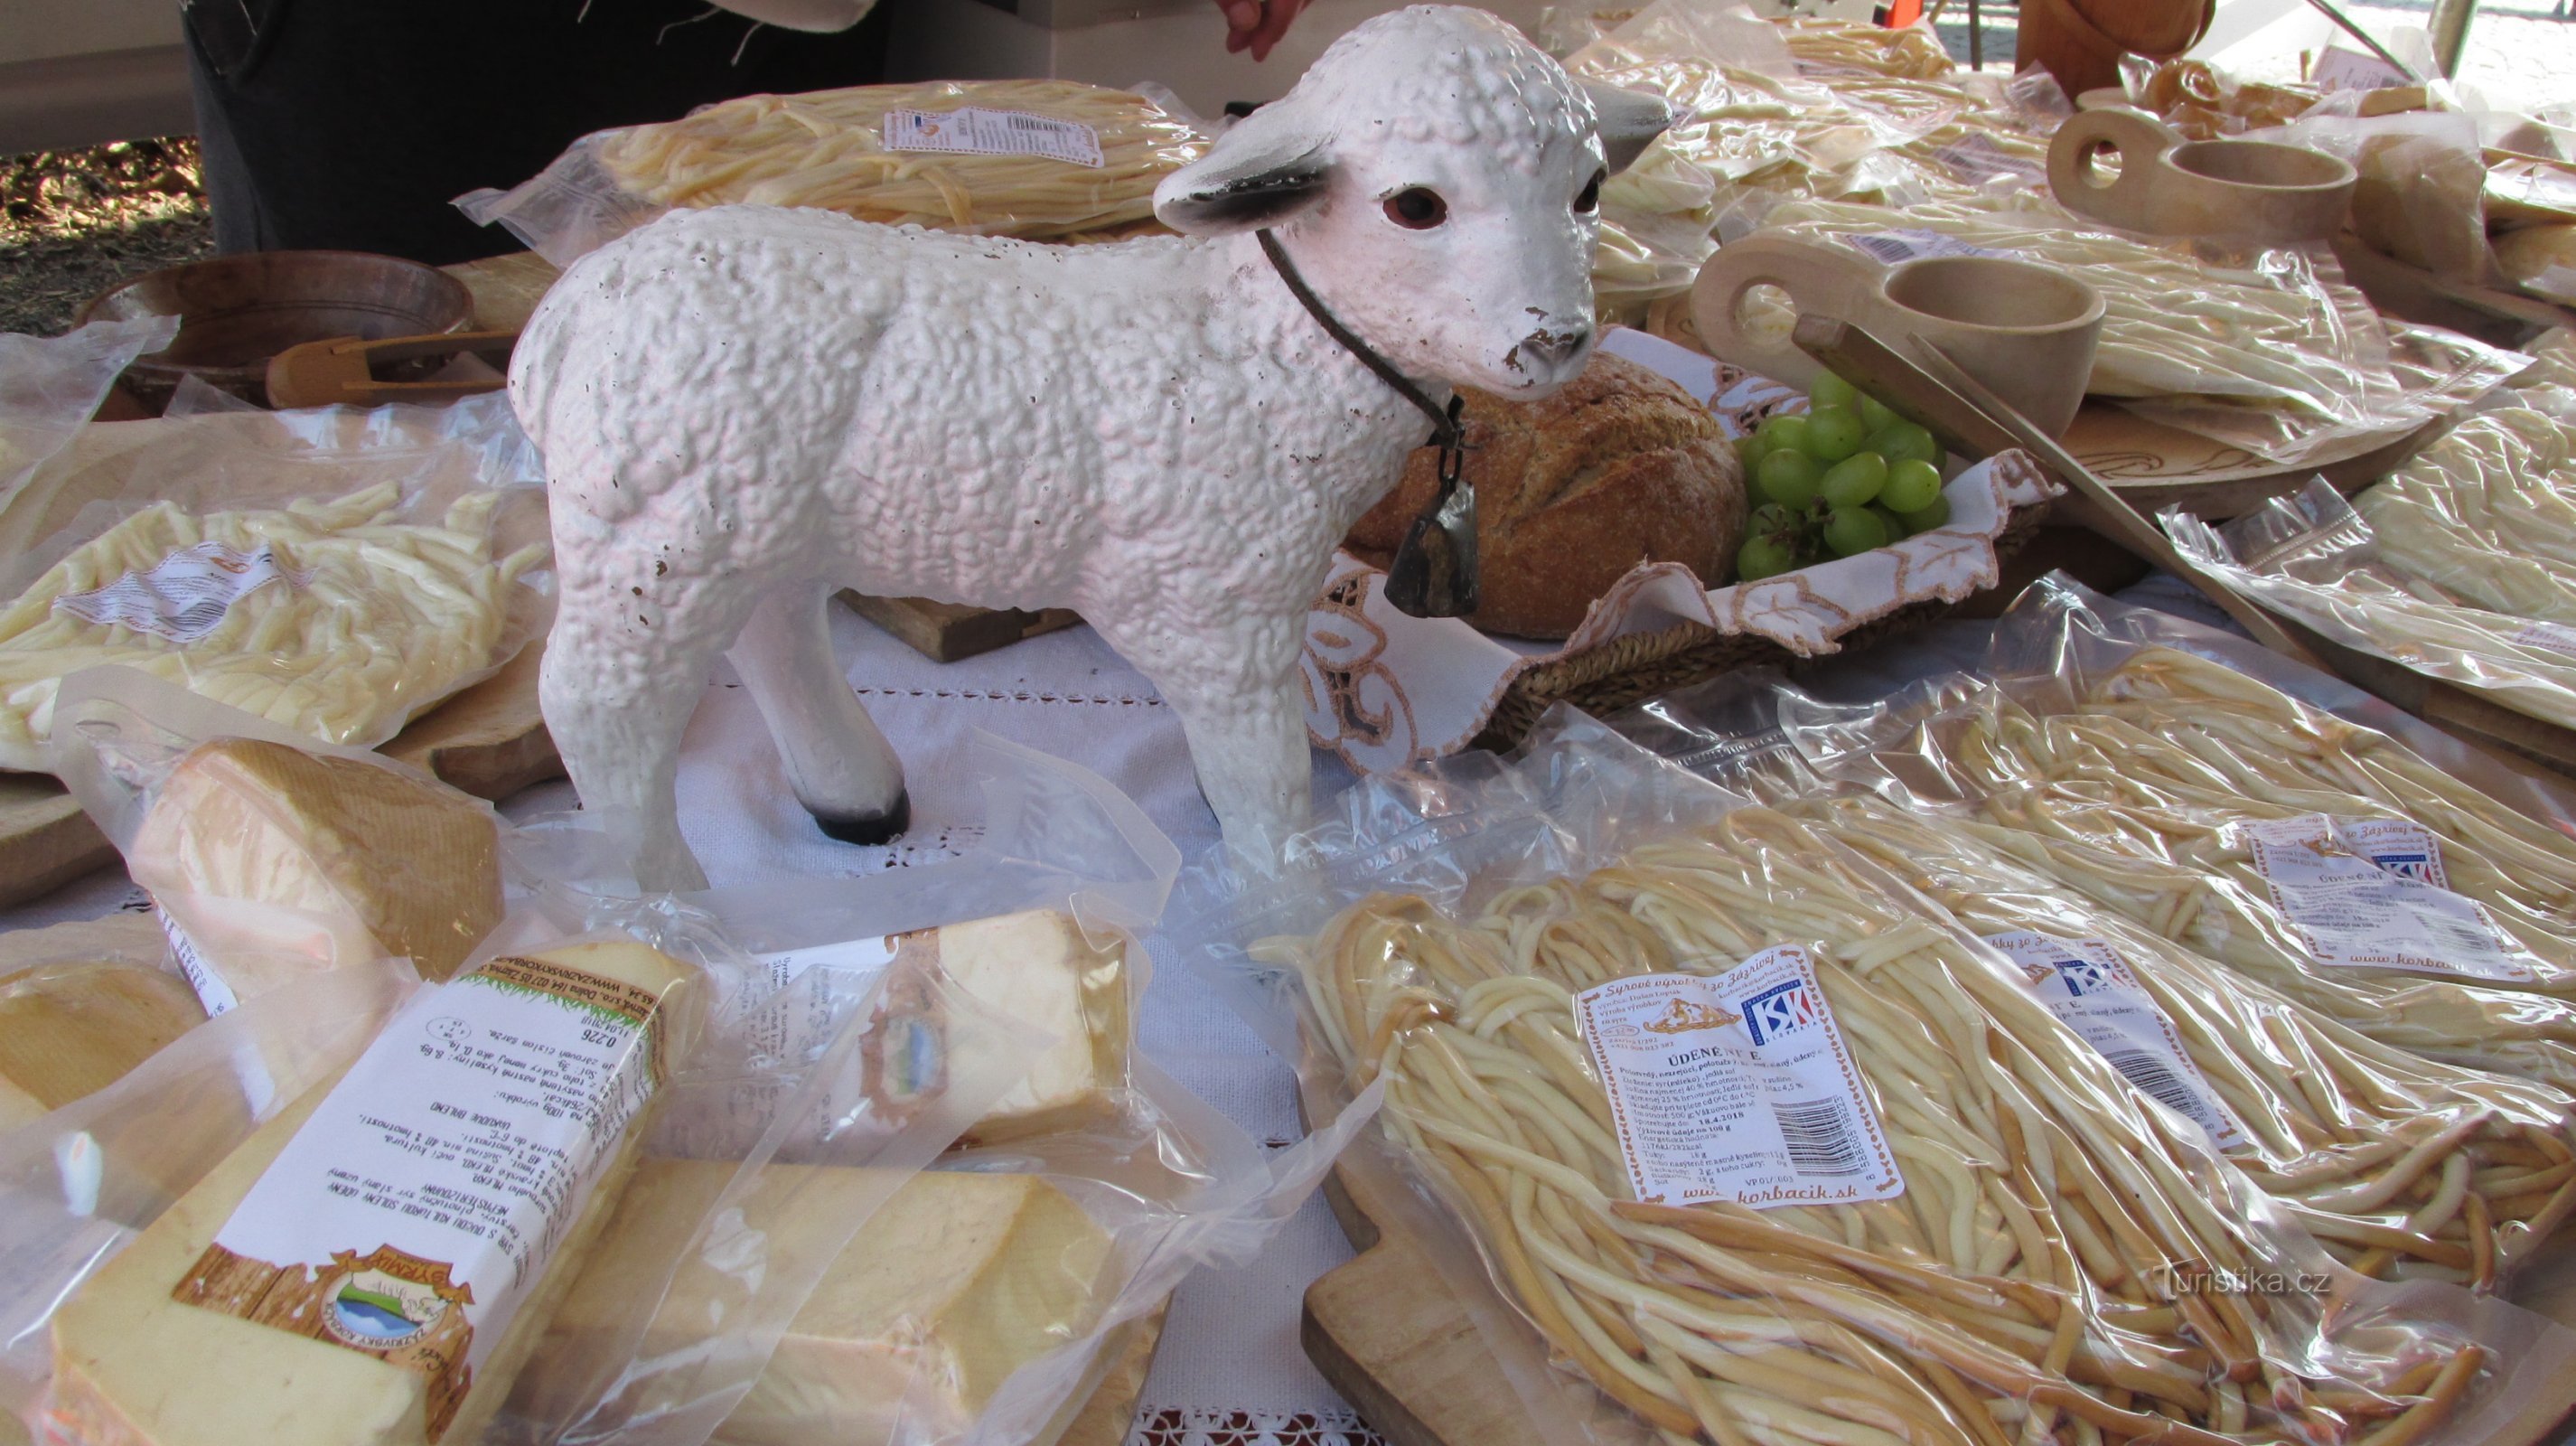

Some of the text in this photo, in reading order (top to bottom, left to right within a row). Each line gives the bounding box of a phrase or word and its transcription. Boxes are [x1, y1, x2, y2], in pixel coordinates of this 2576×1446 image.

[519, 972, 532, 982] 05
[1606, 980, 1651, 998] Syrové
[1728, 951, 1775, 988] Zázrivej
[530, 977, 549, 988] 027
[551, 978, 568, 992] 164,
[570, 984, 597, 1000] Dolina
[629, 986, 642, 1000] 34,
[581, 1028, 617, 1048] 0.226
[476, 1049, 495, 1061] ako
[1668, 1047, 1722, 1066] ÚDENÉ
[529, 1064, 558, 1078] cukry
[562, 1074, 585, 1086] toho
[493, 1091, 584, 1122] na 100g výrobku:
[359, 1113, 413, 1140] hmotnosti.
[1699, 1112, 1745, 1126] 18.4.2018
[1708, 1124, 1724, 1132] 100
[461, 1132, 515, 1156] hmotnosti.
[513, 1135, 528, 1147] do
[465, 1147, 502, 1164] Sušina
[327, 1167, 359, 1183] uzený
[362, 1178, 393, 1194] slaný
[419, 1194, 476, 1216] plnotučný
[487, 1228, 498, 1239] S
